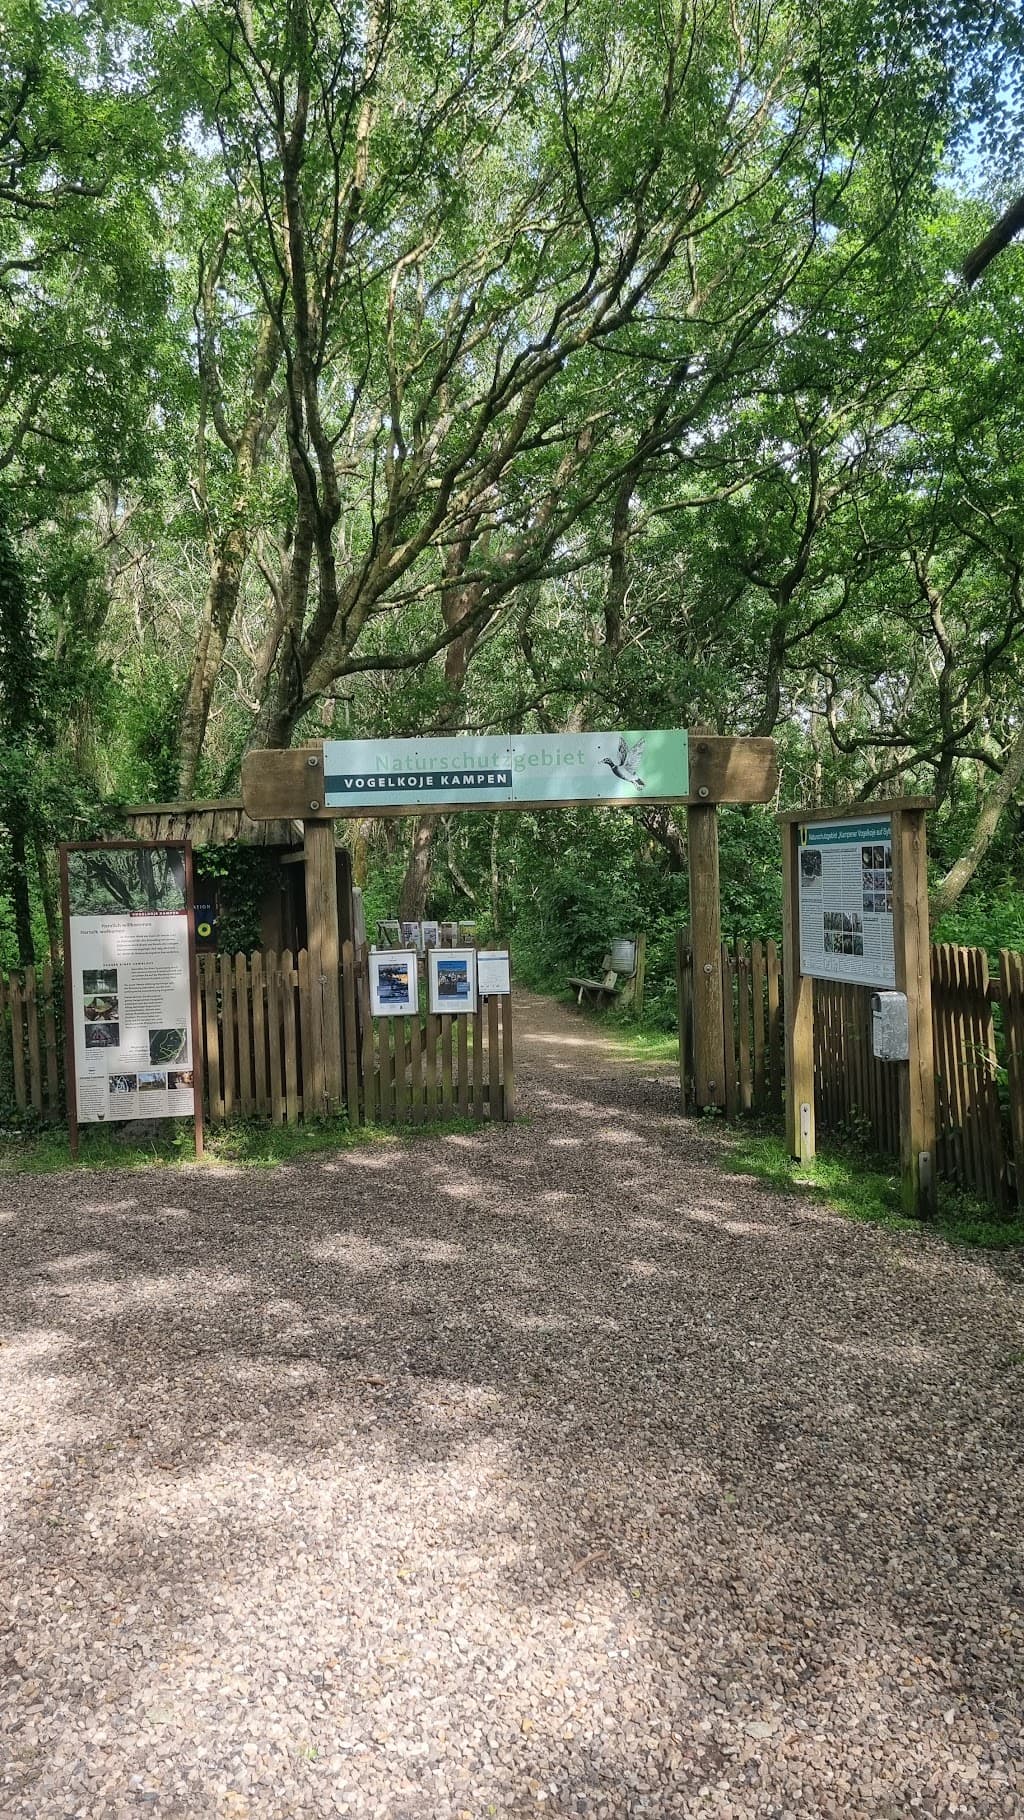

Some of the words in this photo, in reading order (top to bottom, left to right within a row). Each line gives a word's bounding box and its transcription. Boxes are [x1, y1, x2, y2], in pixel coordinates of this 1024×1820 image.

[375, 749, 585, 772] Naturschutzgebiet
[344, 776, 434, 789] VOGELKOJE
[440, 773, 507, 786] KAMPEN
